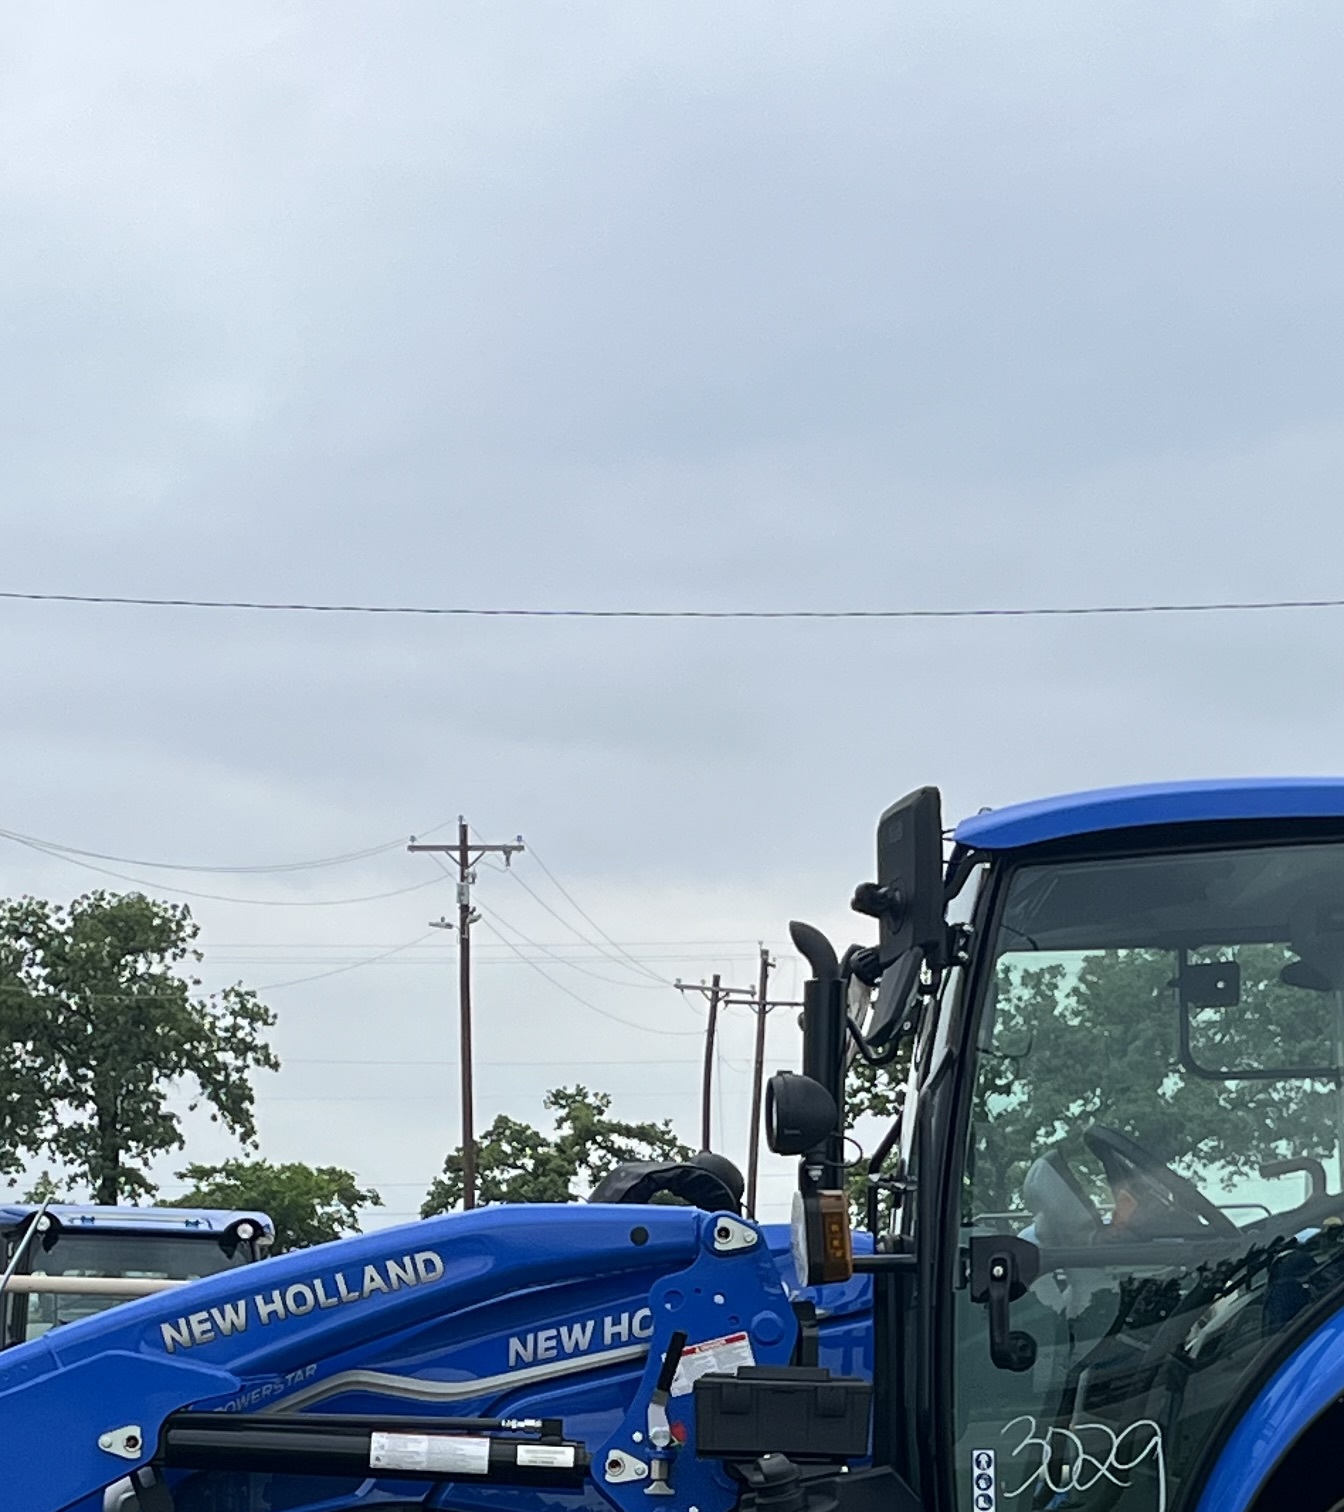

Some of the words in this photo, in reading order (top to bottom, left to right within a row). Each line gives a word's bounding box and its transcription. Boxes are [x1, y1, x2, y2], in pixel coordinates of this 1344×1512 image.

[160, 1299, 247, 1355] NEW
[255, 1250, 445, 1326] HOLLAND
[507, 1320, 596, 1368] NEW
